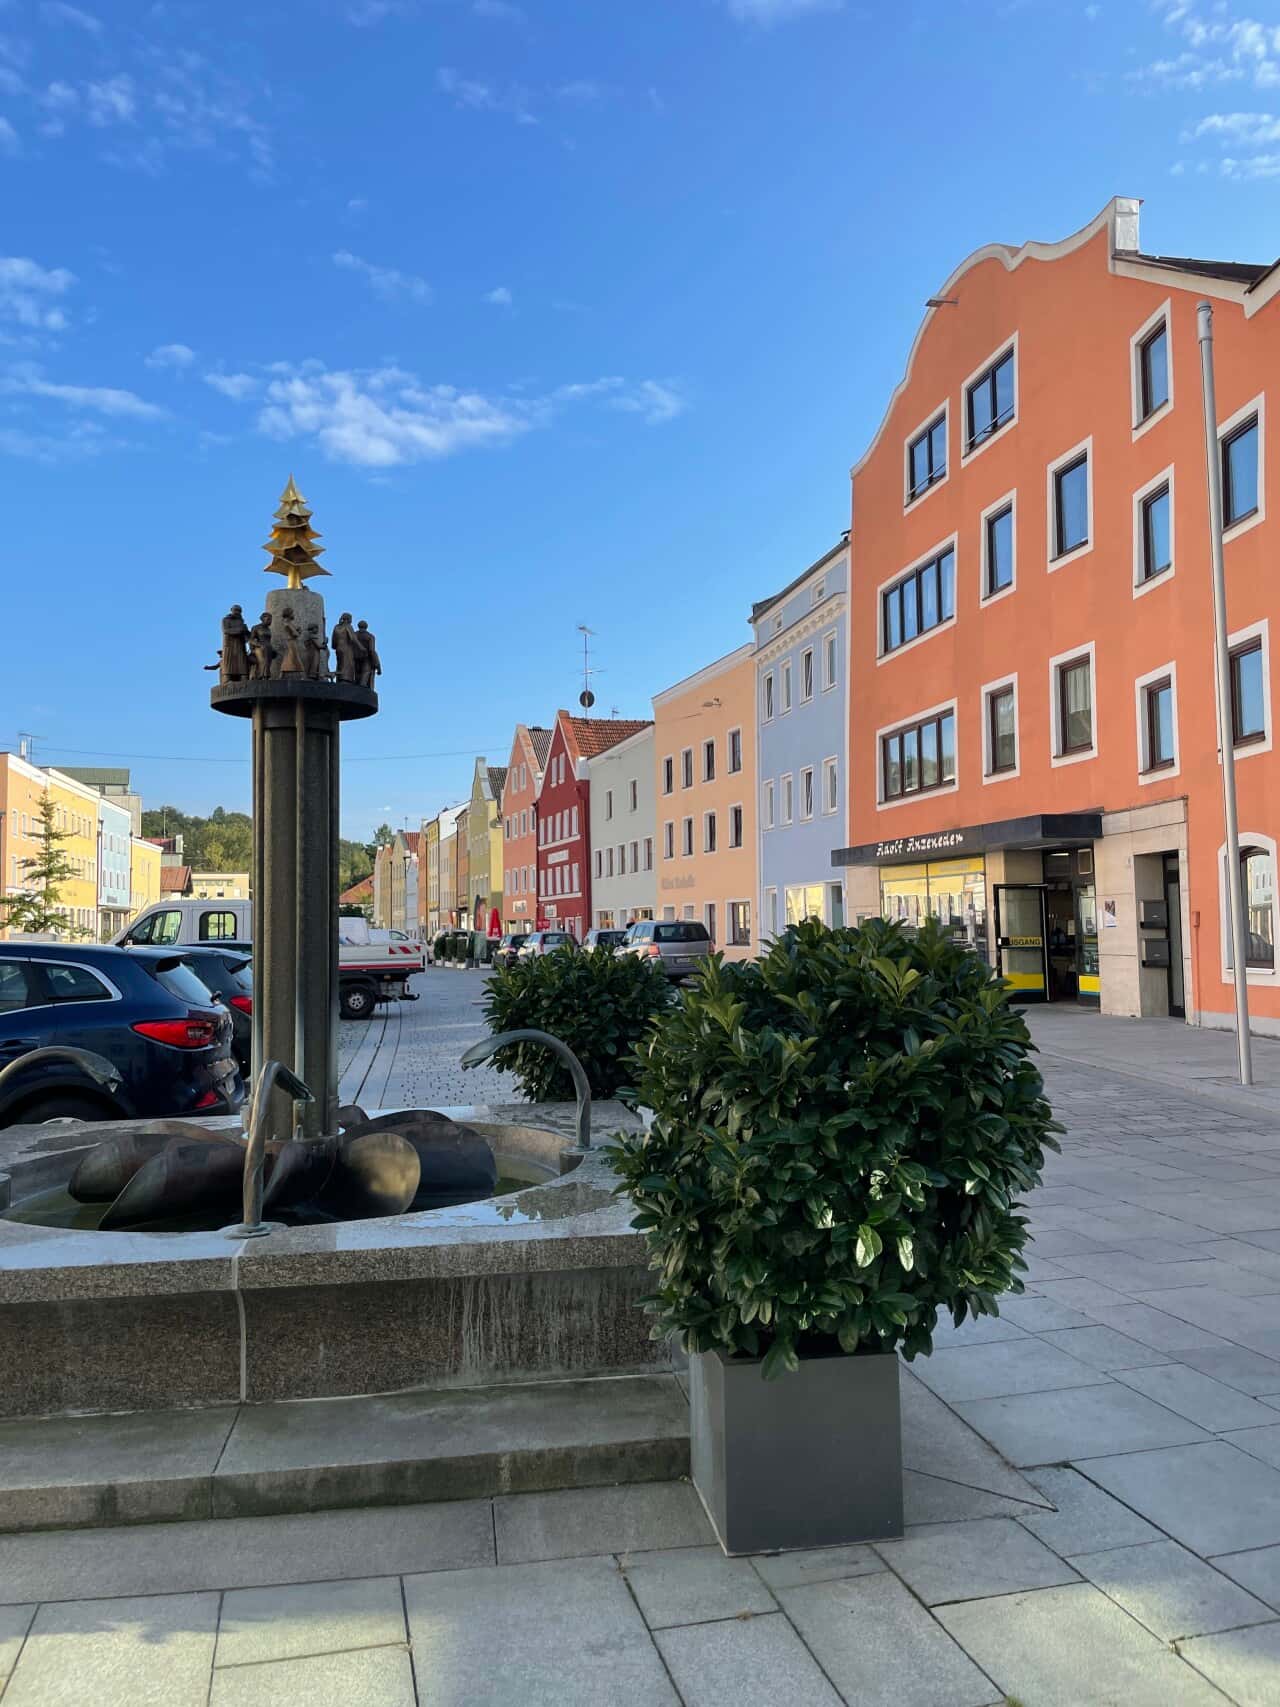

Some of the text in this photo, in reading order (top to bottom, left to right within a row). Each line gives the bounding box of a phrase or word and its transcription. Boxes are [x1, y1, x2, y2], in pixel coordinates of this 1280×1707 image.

[876, 832, 964, 857] Adolf Anzeneder
[1008, 937, 1040, 946] USGANG
